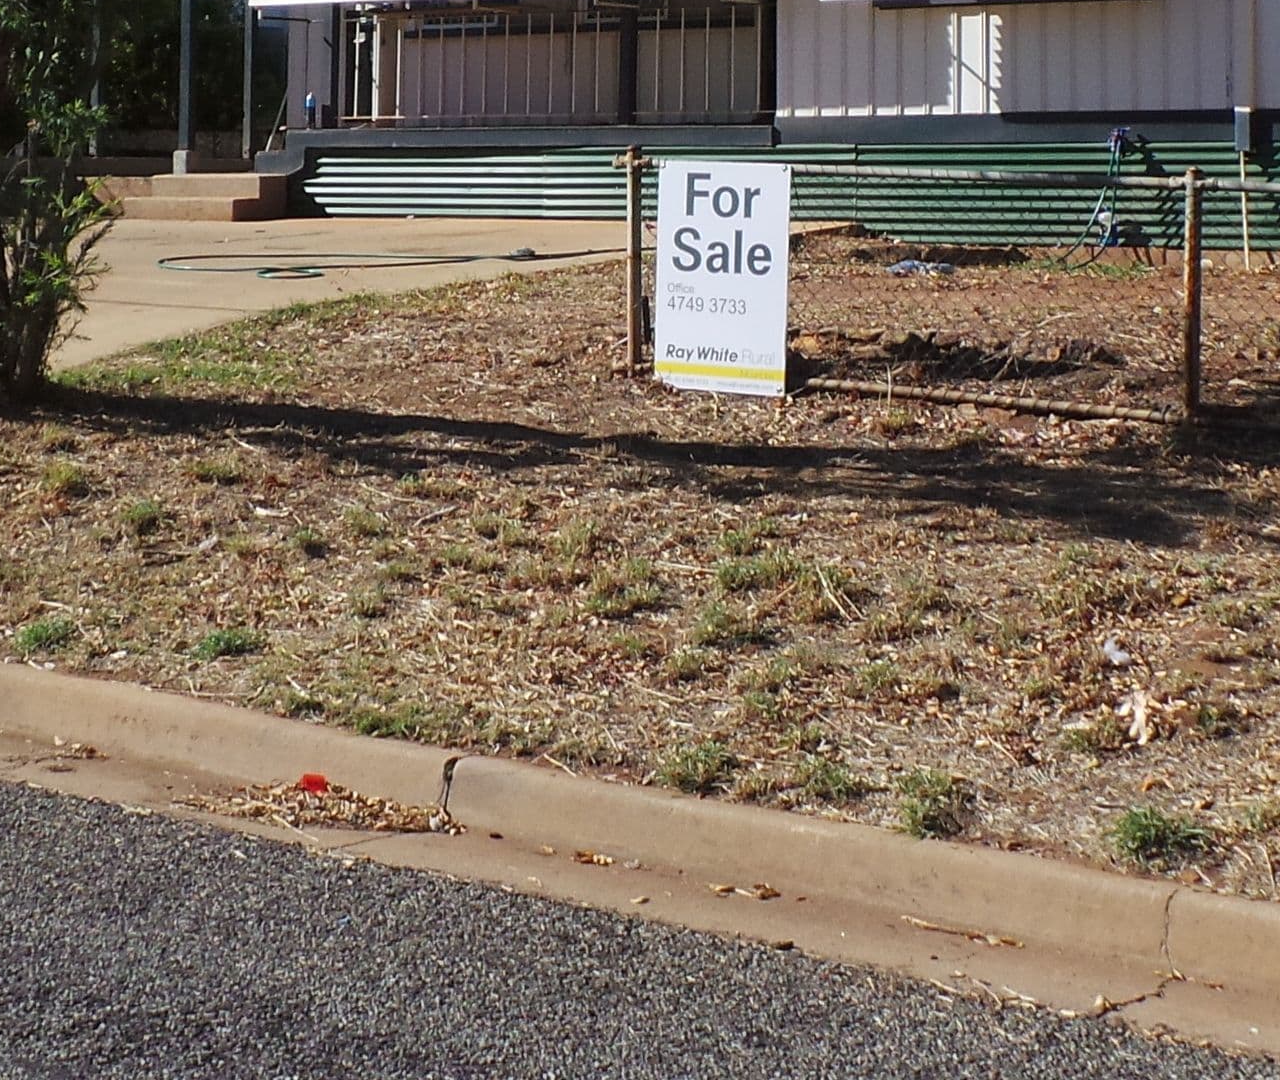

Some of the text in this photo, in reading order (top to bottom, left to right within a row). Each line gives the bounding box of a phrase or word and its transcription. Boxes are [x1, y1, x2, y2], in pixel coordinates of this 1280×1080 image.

[686, 172, 761, 219] For
[672, 227, 772, 276] Sale
[667, 283, 695, 294] Office
[667, 296, 747, 315] 4749 3733
[666, 344, 776, 366] Ray White Rural
